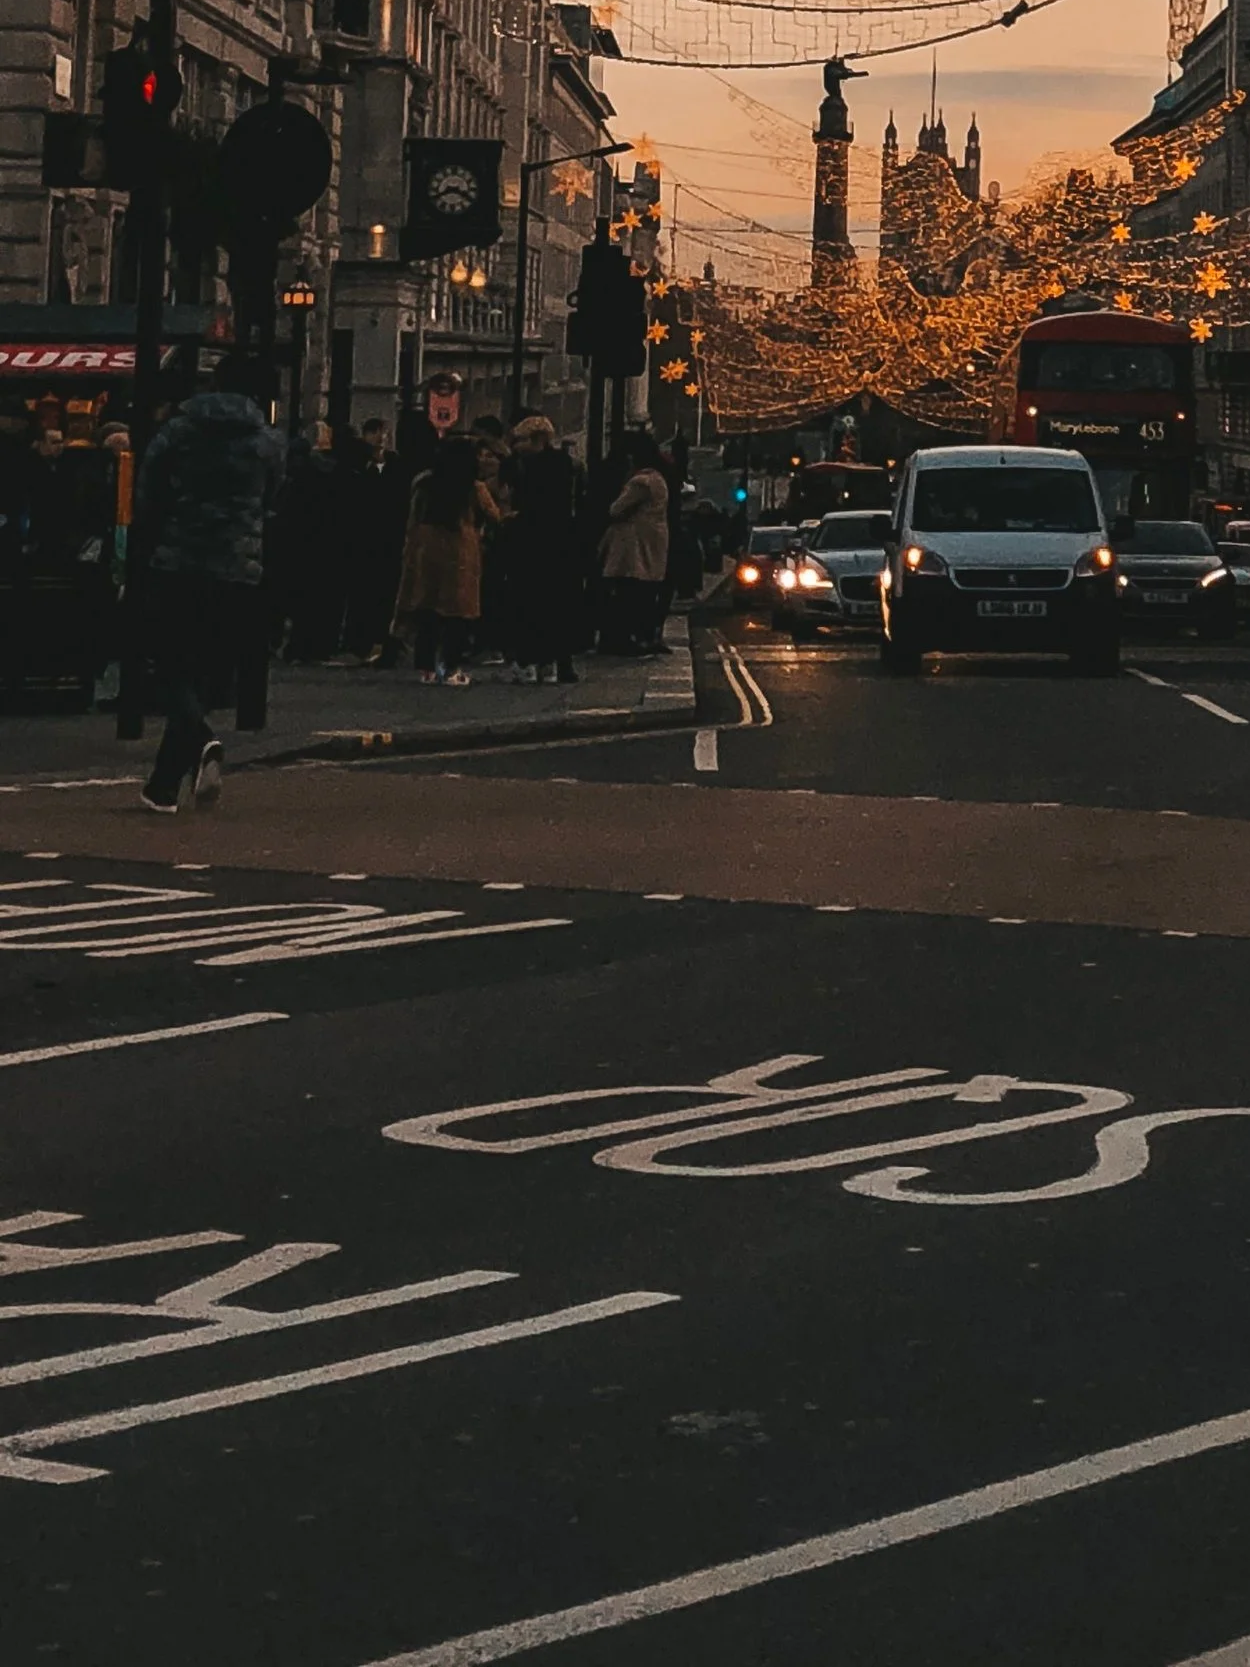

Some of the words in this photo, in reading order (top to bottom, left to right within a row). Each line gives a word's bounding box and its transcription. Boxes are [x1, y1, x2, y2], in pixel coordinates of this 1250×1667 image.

[0, 350, 137, 368] URS
[1050, 420, 1120, 436] Marylebone
[1138, 421, 1165, 441] 453
